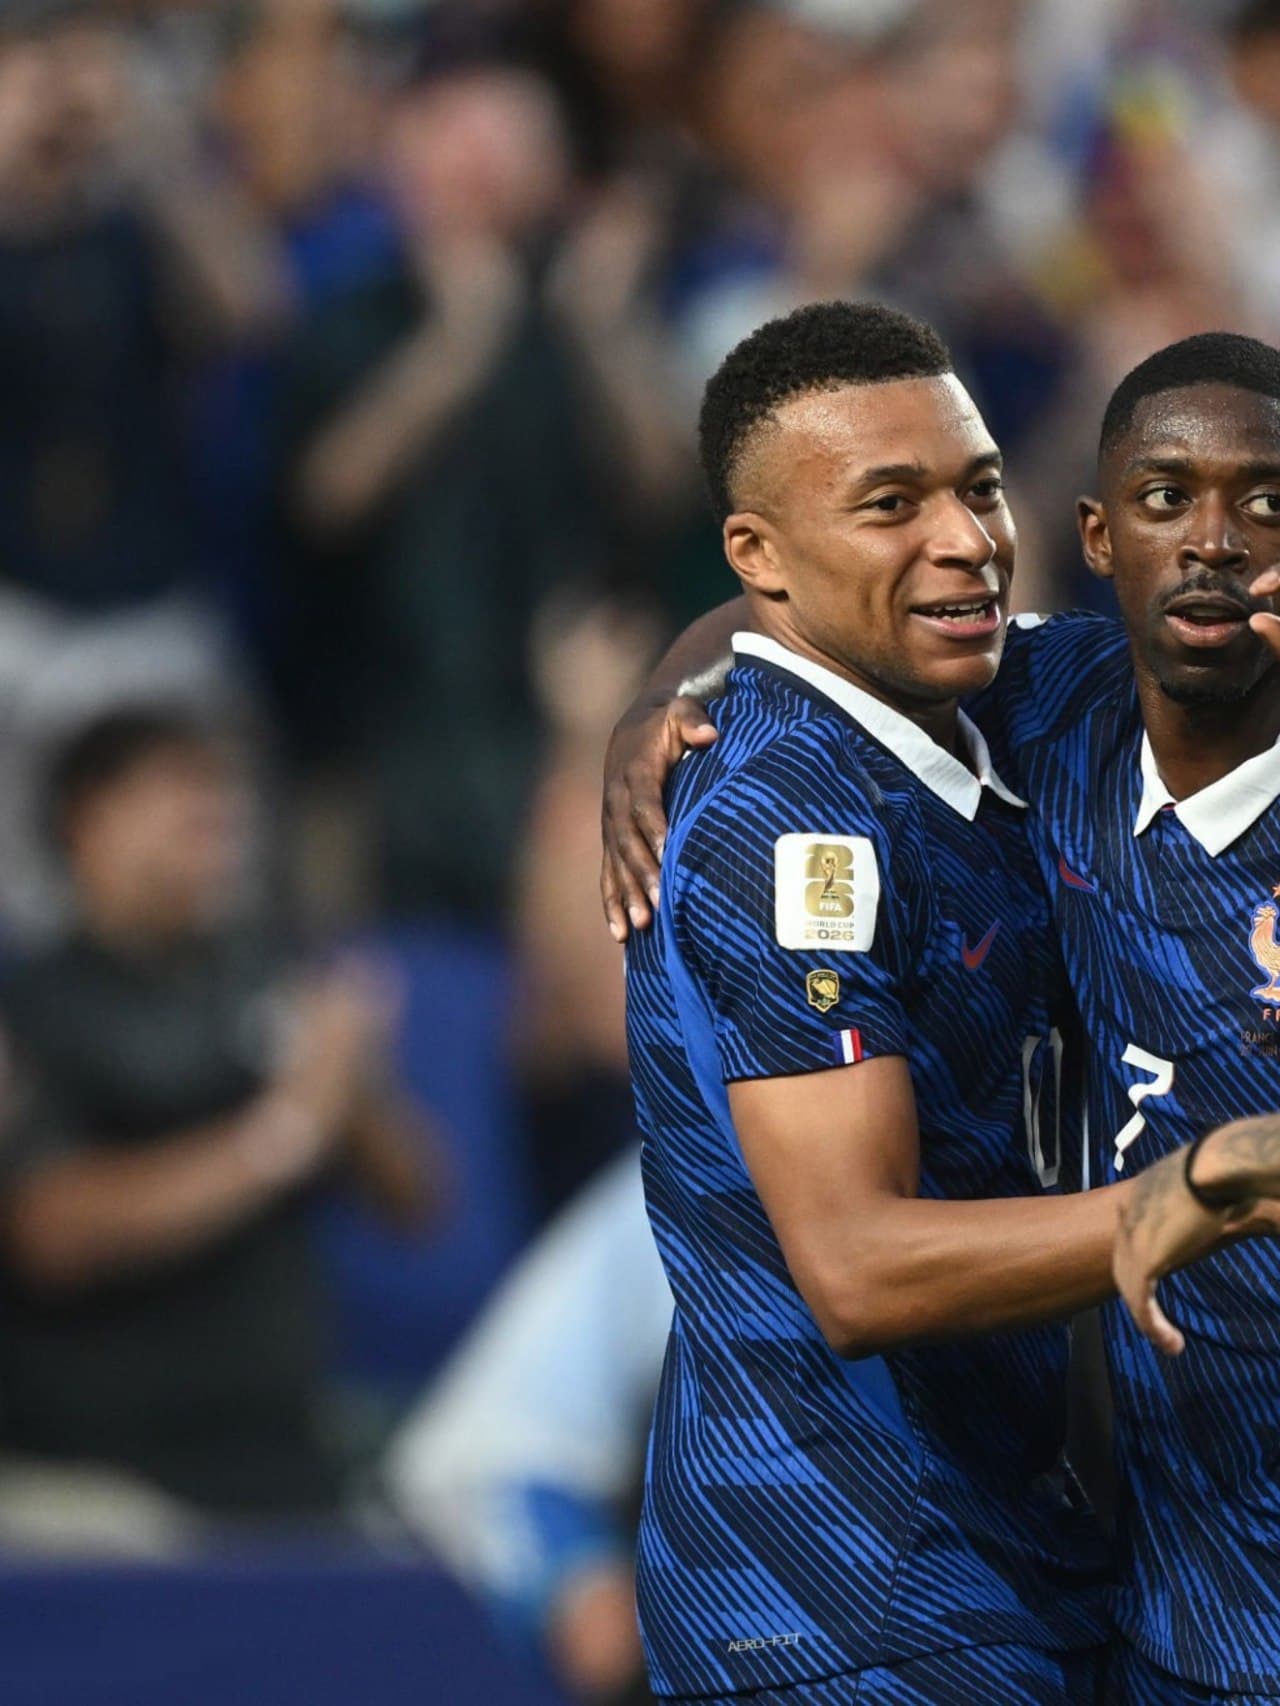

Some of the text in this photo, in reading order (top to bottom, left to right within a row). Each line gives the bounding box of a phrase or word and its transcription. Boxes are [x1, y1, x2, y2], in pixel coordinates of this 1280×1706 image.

[819, 902, 843, 913] FIFA
[838, 921, 855, 930] CUP
[804, 928, 855, 941] 2026
[1240, 1029, 1275, 1042] FRANC
[1113, 1043, 1175, 1172] 7
